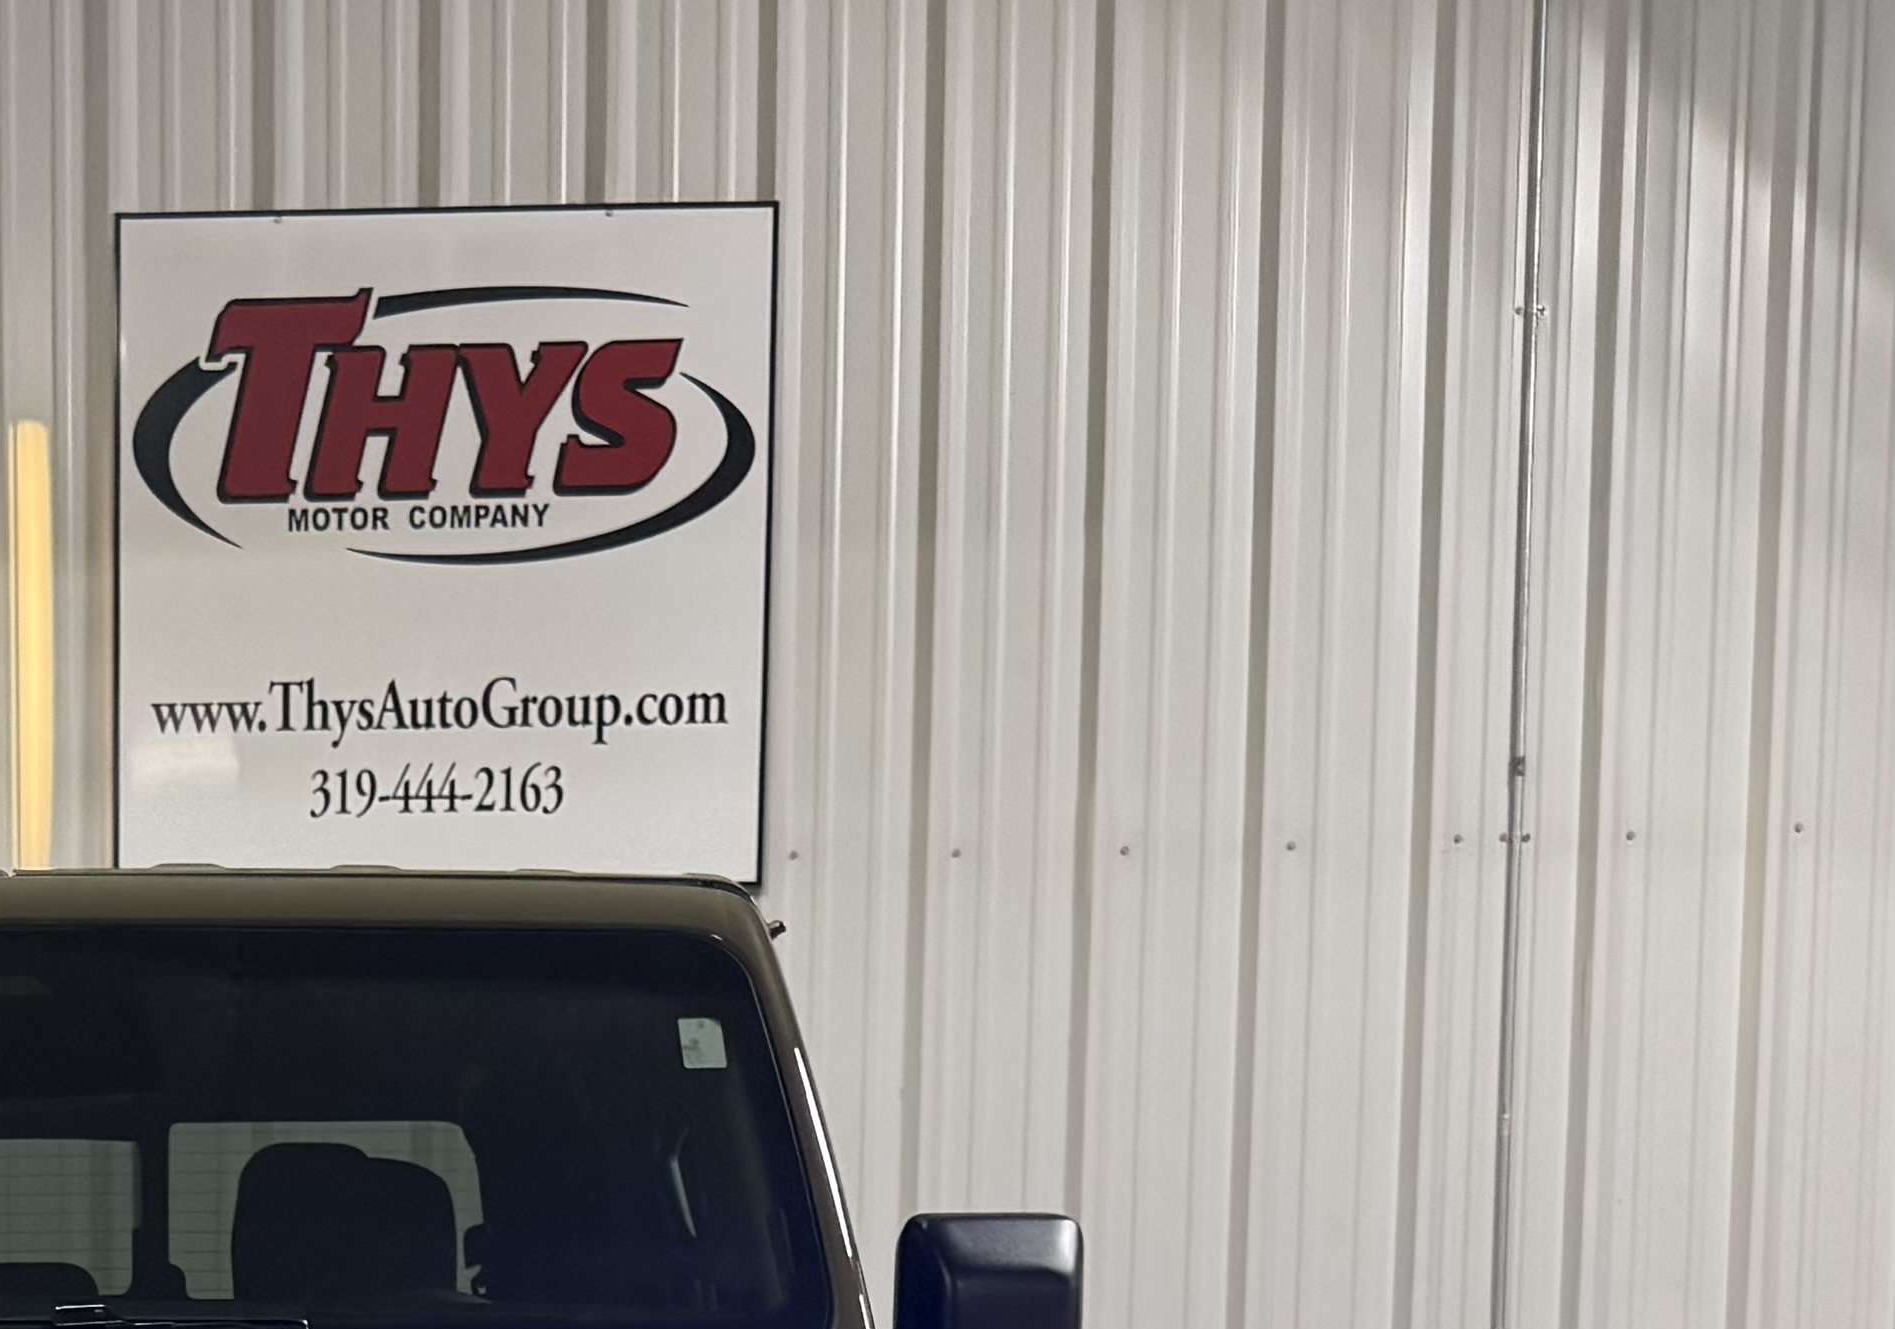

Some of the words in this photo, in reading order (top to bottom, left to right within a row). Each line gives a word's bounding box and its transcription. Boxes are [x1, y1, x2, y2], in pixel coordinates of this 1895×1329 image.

[205, 286, 684, 503] THYS
[288, 506, 391, 533] MOTOR
[408, 503, 550, 530] COMPANY
[151, 676, 728, 749] www.ThysAutoGroup.com
[310, 762, 564, 818] 319-444-2163
